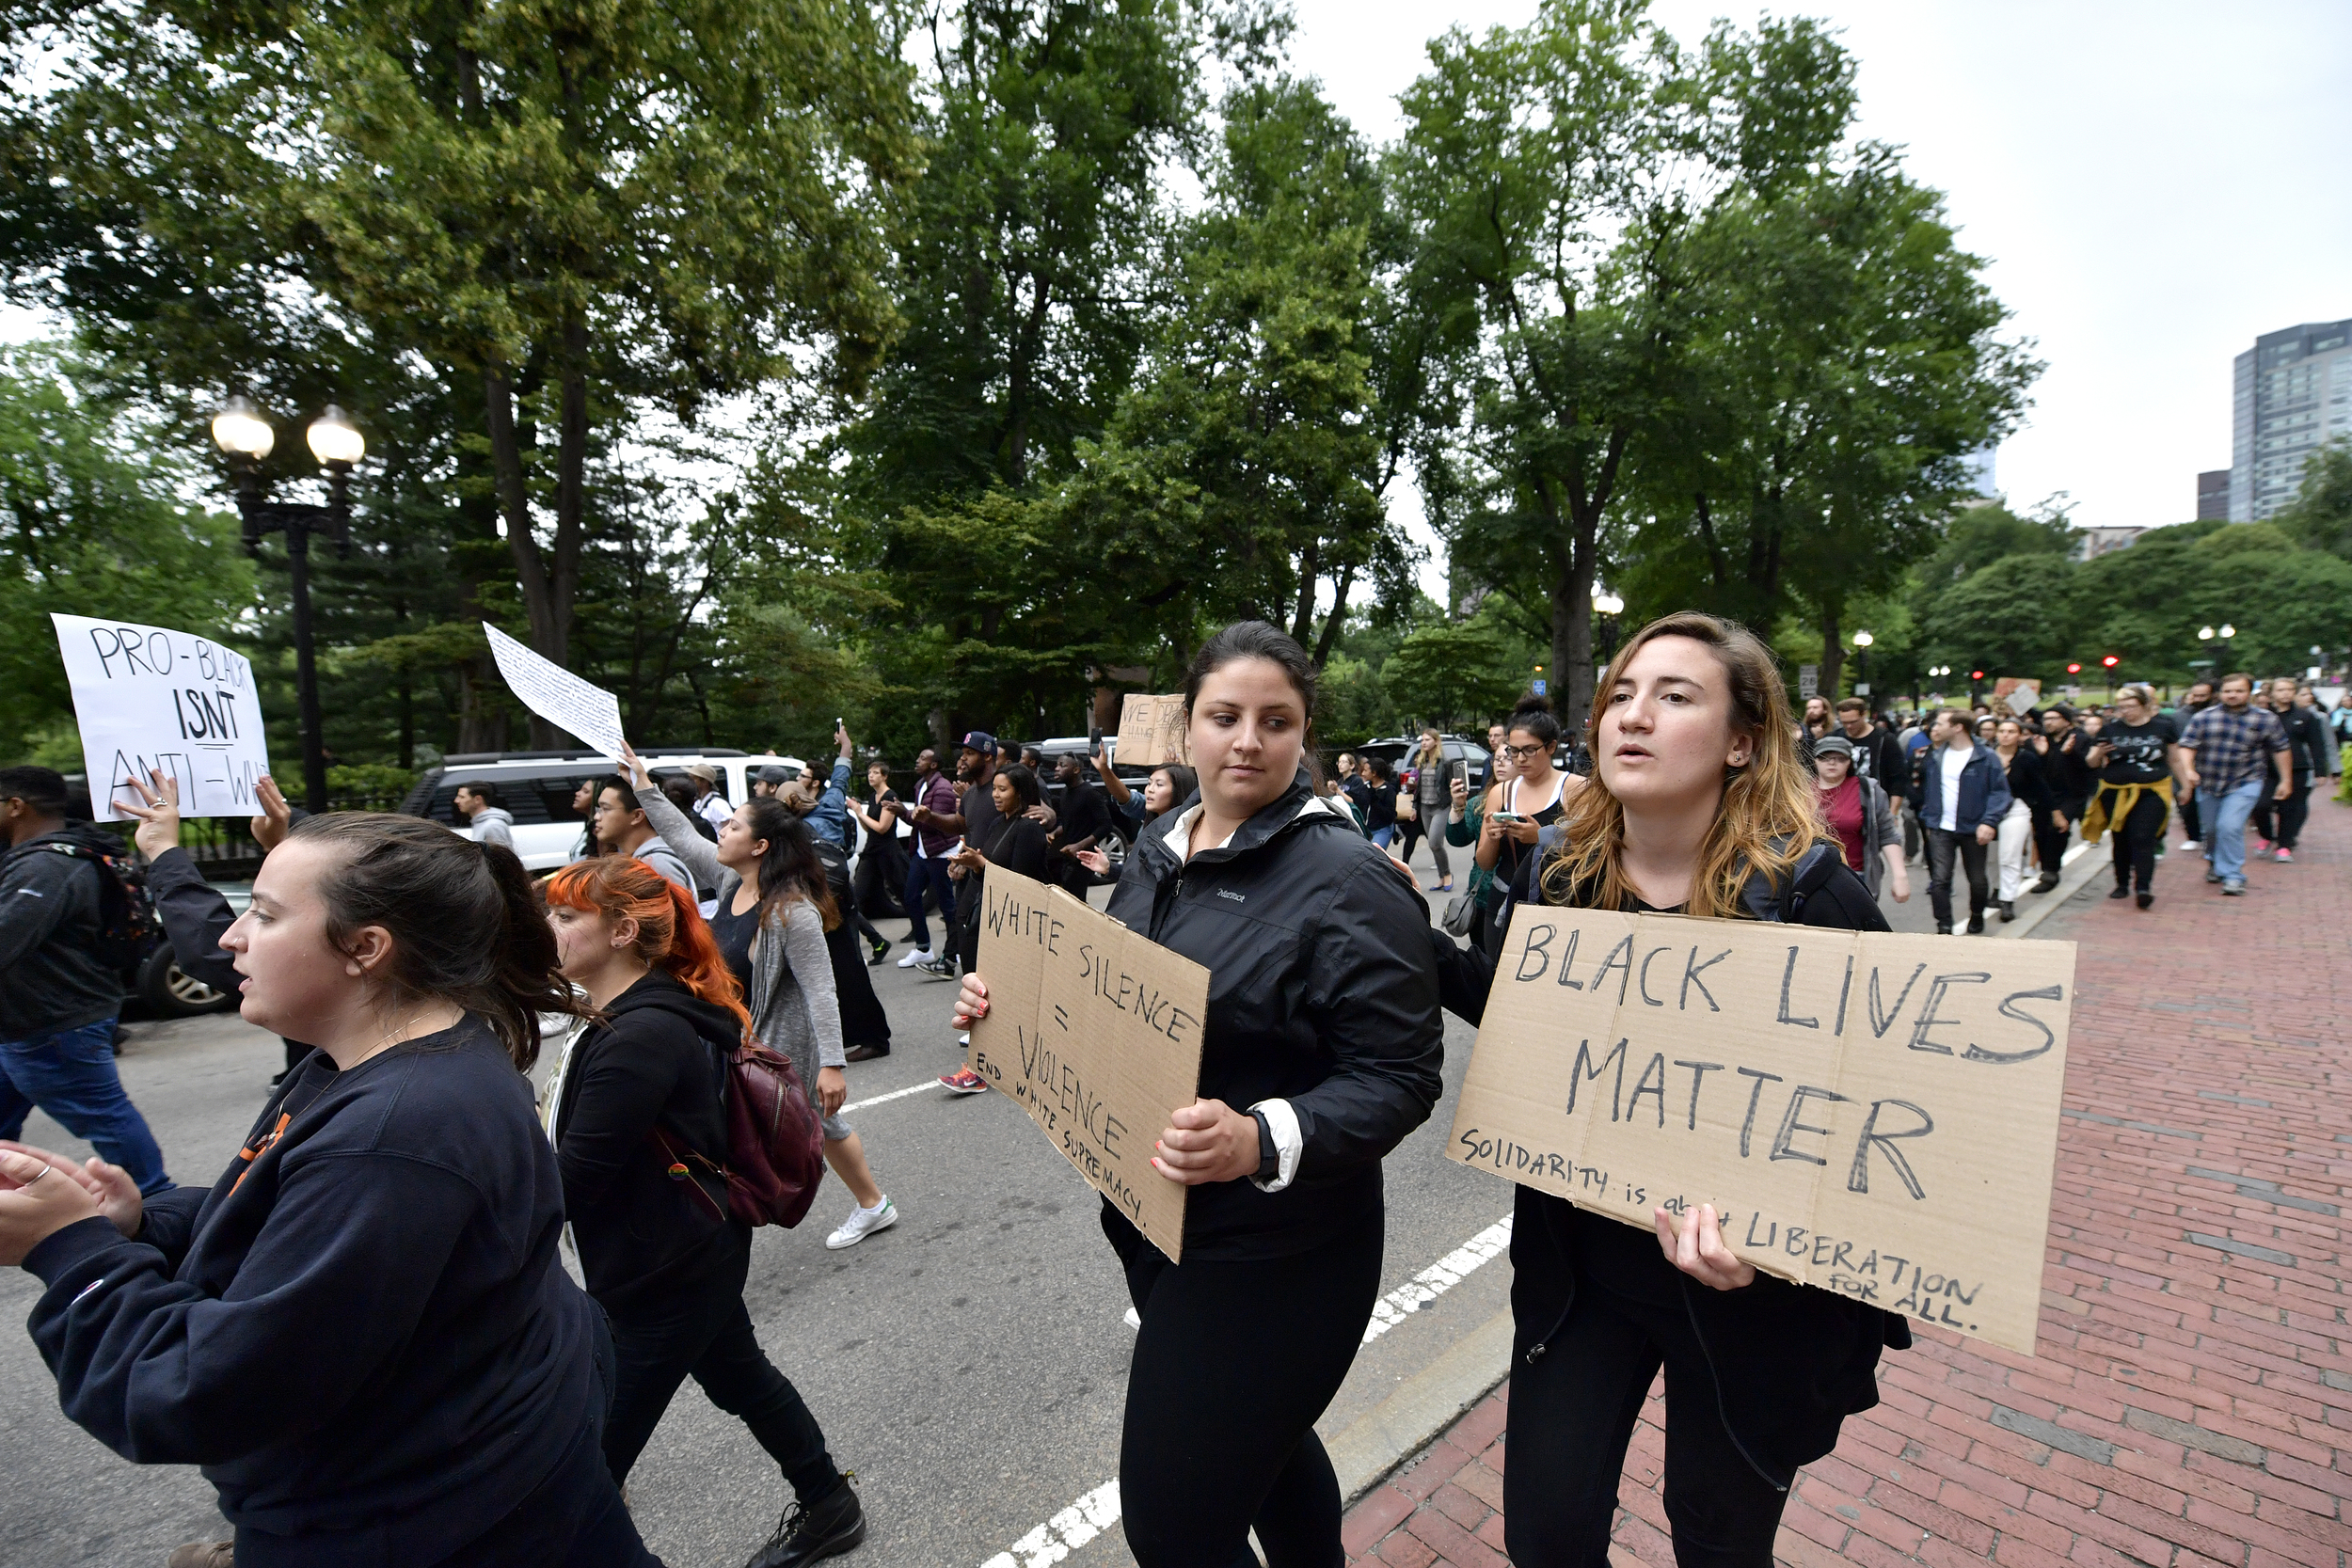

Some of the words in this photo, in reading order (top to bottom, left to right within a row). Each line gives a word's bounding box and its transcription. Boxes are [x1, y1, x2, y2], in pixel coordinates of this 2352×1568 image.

[988, 884, 1065, 958] WHITE
[1079, 944, 1200, 1043] SILENCE
[1514, 924, 1733, 1013] BLACK
[1776, 945, 2063, 1065] LIVES
[977, 1052, 1002, 1081] END
[1016, 1081, 1057, 1131] WHITE
[1018, 1024, 1129, 1161] VIOLENCE
[1566, 1037, 1934, 1201] MATTER
[1744, 1212, 1983, 1307] LIBERATION
[1828, 1273, 1880, 1300] FOR
